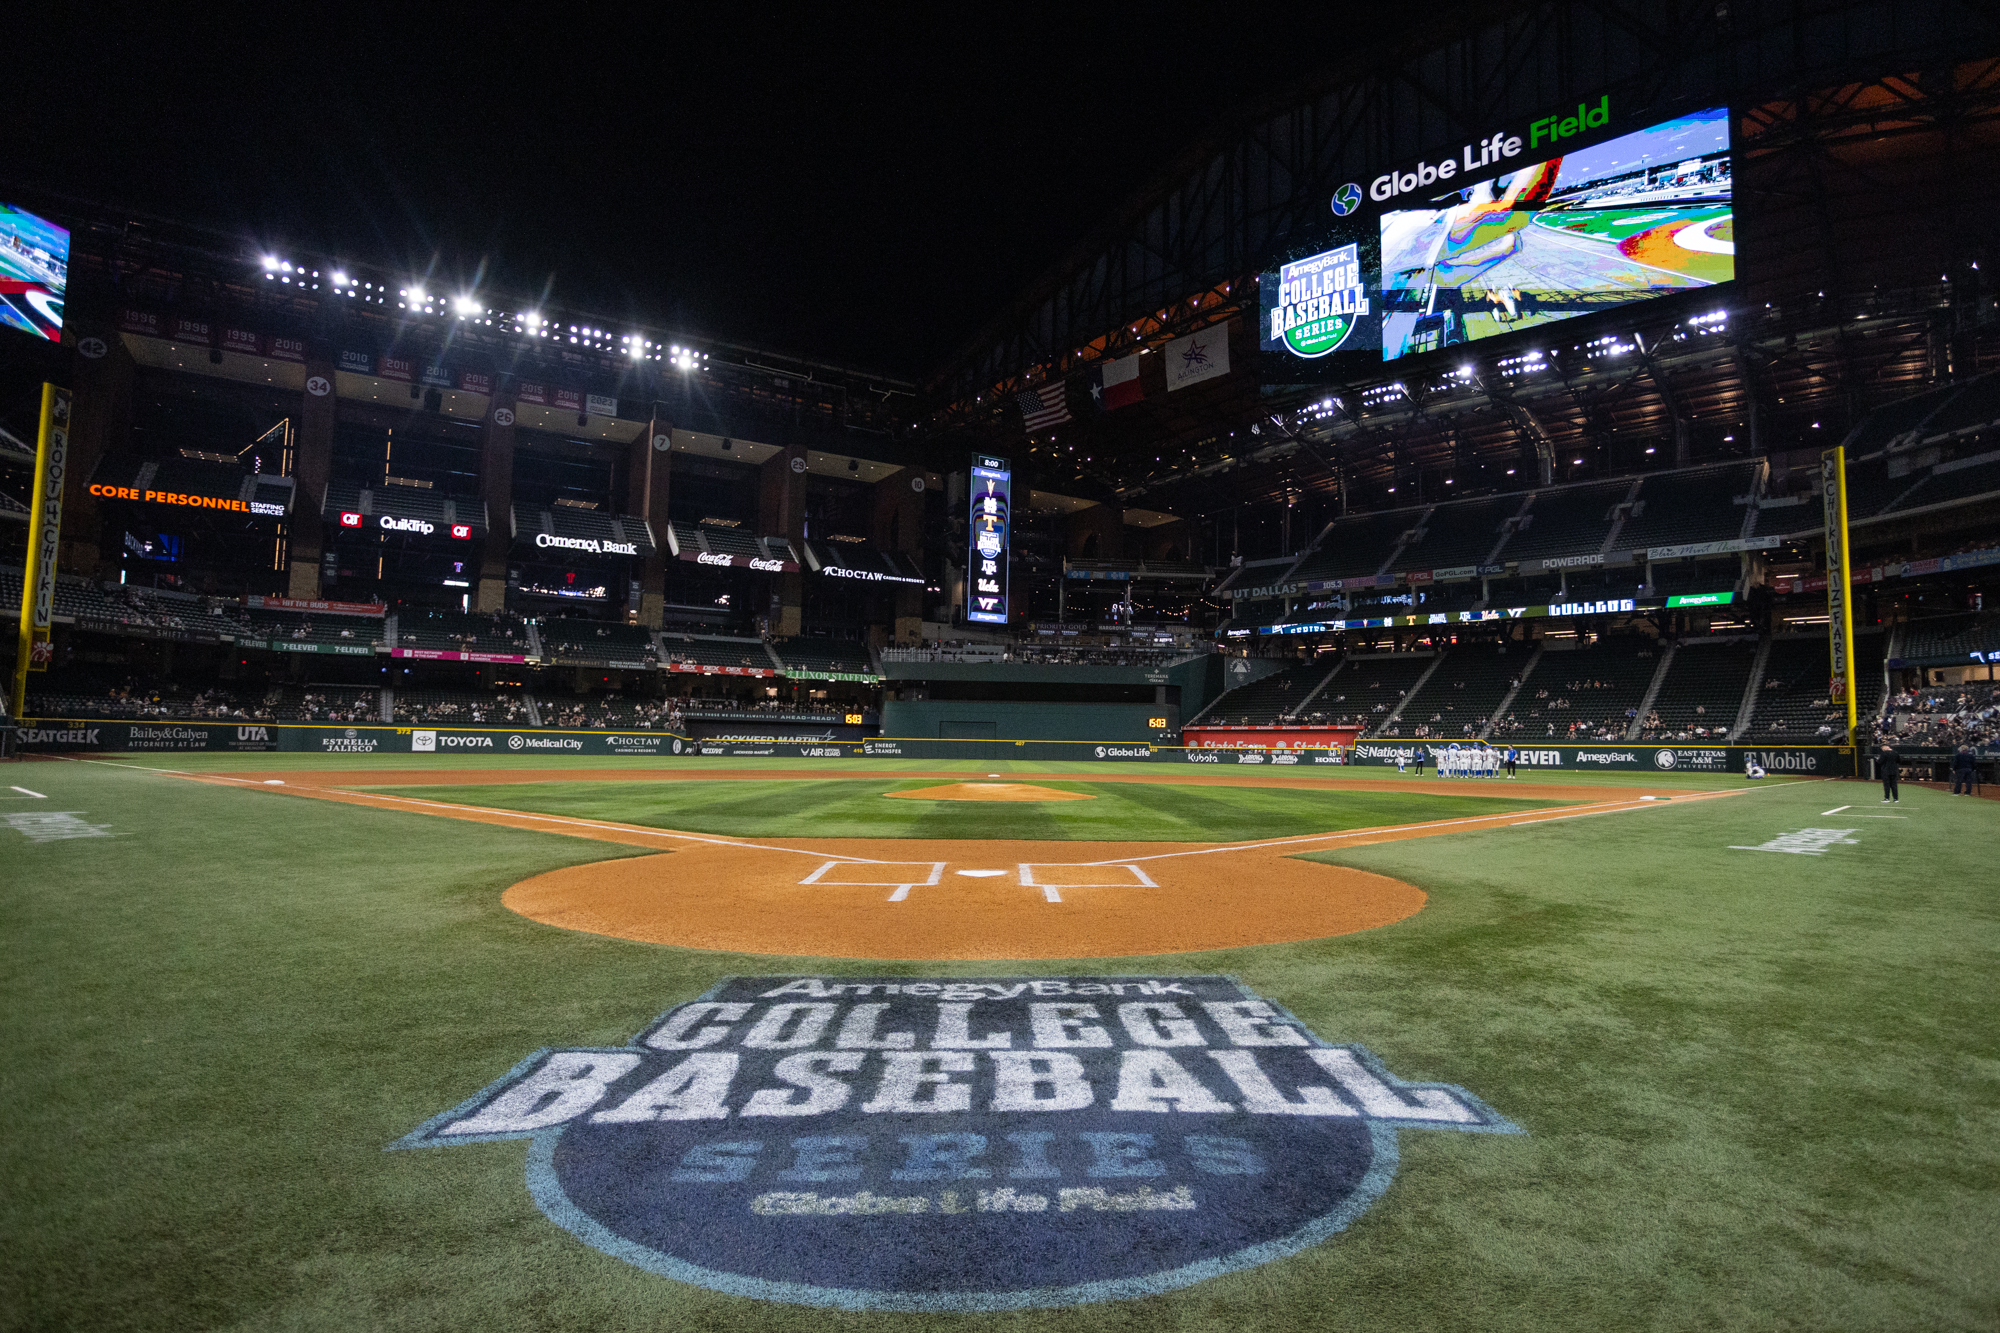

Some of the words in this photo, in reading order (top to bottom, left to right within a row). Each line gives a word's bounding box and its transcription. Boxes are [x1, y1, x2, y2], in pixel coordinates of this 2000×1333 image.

[1369, 157, 1457, 202] Globe
[1463, 132, 1522, 173] Life
[1530, 94, 1609, 149] Field
[1288, 251, 1351, 279] AmegyBank
[1280, 262, 1358, 307] COLLEGE
[126, 310, 157, 325] 1996
[1272, 286, 1368, 338] BASEBALL
[179, 320, 209, 334] 1998
[1295, 318, 1343, 340] SERIES
[227, 329, 256, 343] 1999
[275, 338, 303, 351] 2010
[342, 350, 368, 363] 2010
[387, 359, 409, 371] 2011
[427, 367, 448, 378] 2011
[311, 380, 327, 392] 34
[497, 411, 512, 422] 26
[658, 438, 666, 448] 7
[46, 432, 64, 497] ROOT
[984, 459, 999, 468] 8:00
[89, 484, 140, 500] CORE
[145, 490, 250, 513] PERSONNEL
[250, 501, 285, 511] STAFFING
[251, 507, 284, 516] SERVICES
[342, 513, 360, 526] QT
[380, 515, 435, 536] QuikTrip
[1825, 482, 1838, 566] CHIKIN
[452, 525, 470, 538] QT
[602, 539, 637, 555] Bank
[1650, 548, 1676, 558] Blue
[1680, 544, 1711, 555] Mint
[697, 551, 733, 567] Coca-Cola
[749, 557, 784, 572] Coca-Cola
[1542, 554, 1605, 568] POWERADE
[823, 566, 883, 581] CHOCTAW
[1435, 568, 1474, 578] GoPGL.com
[1484, 565, 1503, 573] PGL
[37, 529, 56, 623] CHIKIN
[1323, 580, 1342, 589] 105.3
[1831, 574, 1841, 596] IZ
[1233, 588, 1250, 599] UT
[1252, 584, 1297, 597] DALLAS
[281, 600, 295, 608] HIT
[295, 600, 309, 608] THE
[309, 601, 329, 609] BUDS
[978, 597, 999, 610] VT
[1507, 607, 1526, 617] VT
[1406, 615, 1416, 625] T
[240, 638, 267, 648] 7-ELEVEN
[1832, 610, 1843, 670] FARE
[282, 643, 318, 652] 7-ELEVEN
[334, 646, 369, 654] 7-ELEVEN
[795, 671, 829, 680] LUXOR
[832, 673, 877, 683] STAFFING
[16, 728, 100, 745] SEATGEEK
[130, 726, 208, 741] Bailey&Galyen
[237, 726, 269, 740] UTA
[322, 738, 378, 746] ESTRELLA
[439, 736, 494, 747] TOYOTA
[525, 738, 563, 748] Medical
[564, 739, 583, 750] City
[606, 736, 661, 746] CHOCTAW
[777, 736, 819, 746] MARTIN
[810, 748, 824, 757] AIR
[1108, 748, 1134, 757] Globe
[1134, 748, 1150, 757] Life
[1188, 754, 1218, 763] Kubota
[1368, 746, 1415, 758] Natioal
[1576, 751, 1635, 764] AmegyBank
[638, 999, 1304, 1051] COLLEGE
[438, 1047, 1487, 1135] BASEBALL
[670, 1132, 1268, 1184] SERIES
